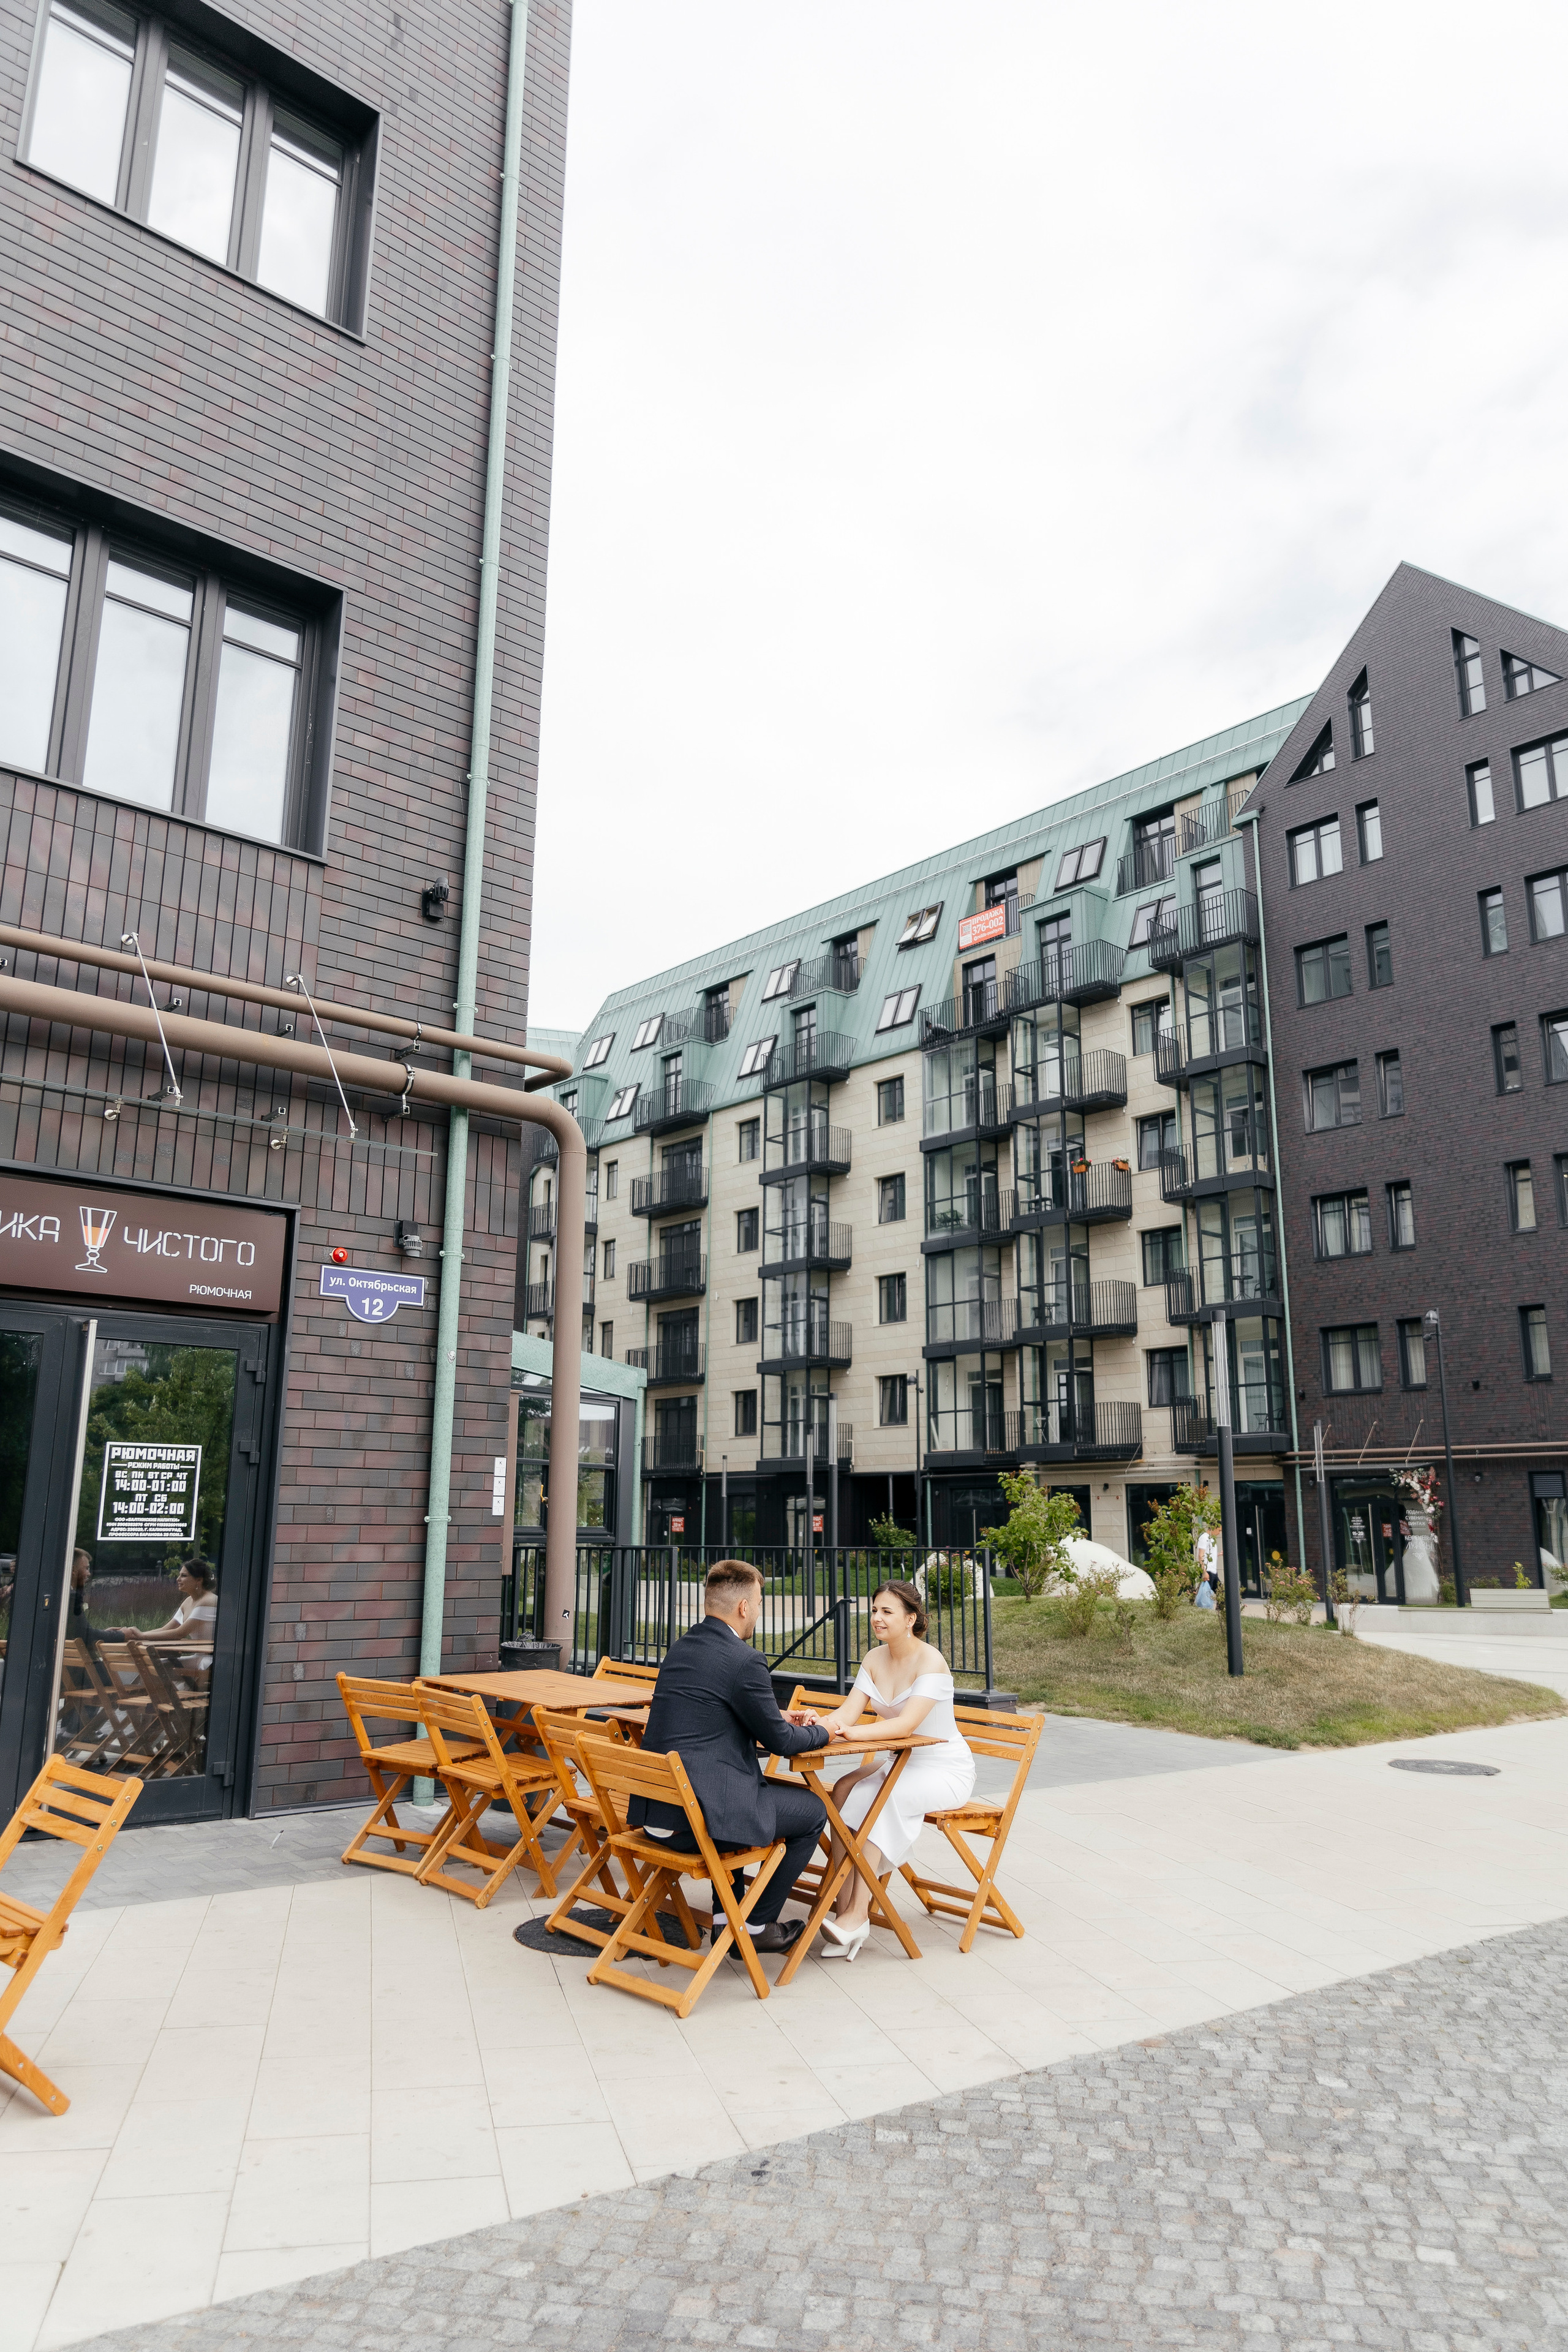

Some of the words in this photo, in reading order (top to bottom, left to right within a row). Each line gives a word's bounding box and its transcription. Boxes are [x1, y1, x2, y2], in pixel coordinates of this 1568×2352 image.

[972, 908, 1003, 925] ПРОДАЖА
[972, 916, 1004, 935] 376-002
[124, 1226, 255, 1266] ЧИСТОГО
[189, 1284, 252, 1300] РЮМОЧНАЯ
[329, 1276, 345, 1287] ул.
[348, 1277, 417, 1294] Октябрьская
[361, 1297, 383, 1316] 12
[111, 1447, 196, 1461] РЮМОЧНАЯ
[115, 1479, 186, 1492] 14:00-01:00
[135, 1493, 148, 1502] ПТ
[154, 1494, 168, 1502] СБ
[113, 1502, 184, 1515] 14:00-02:00
